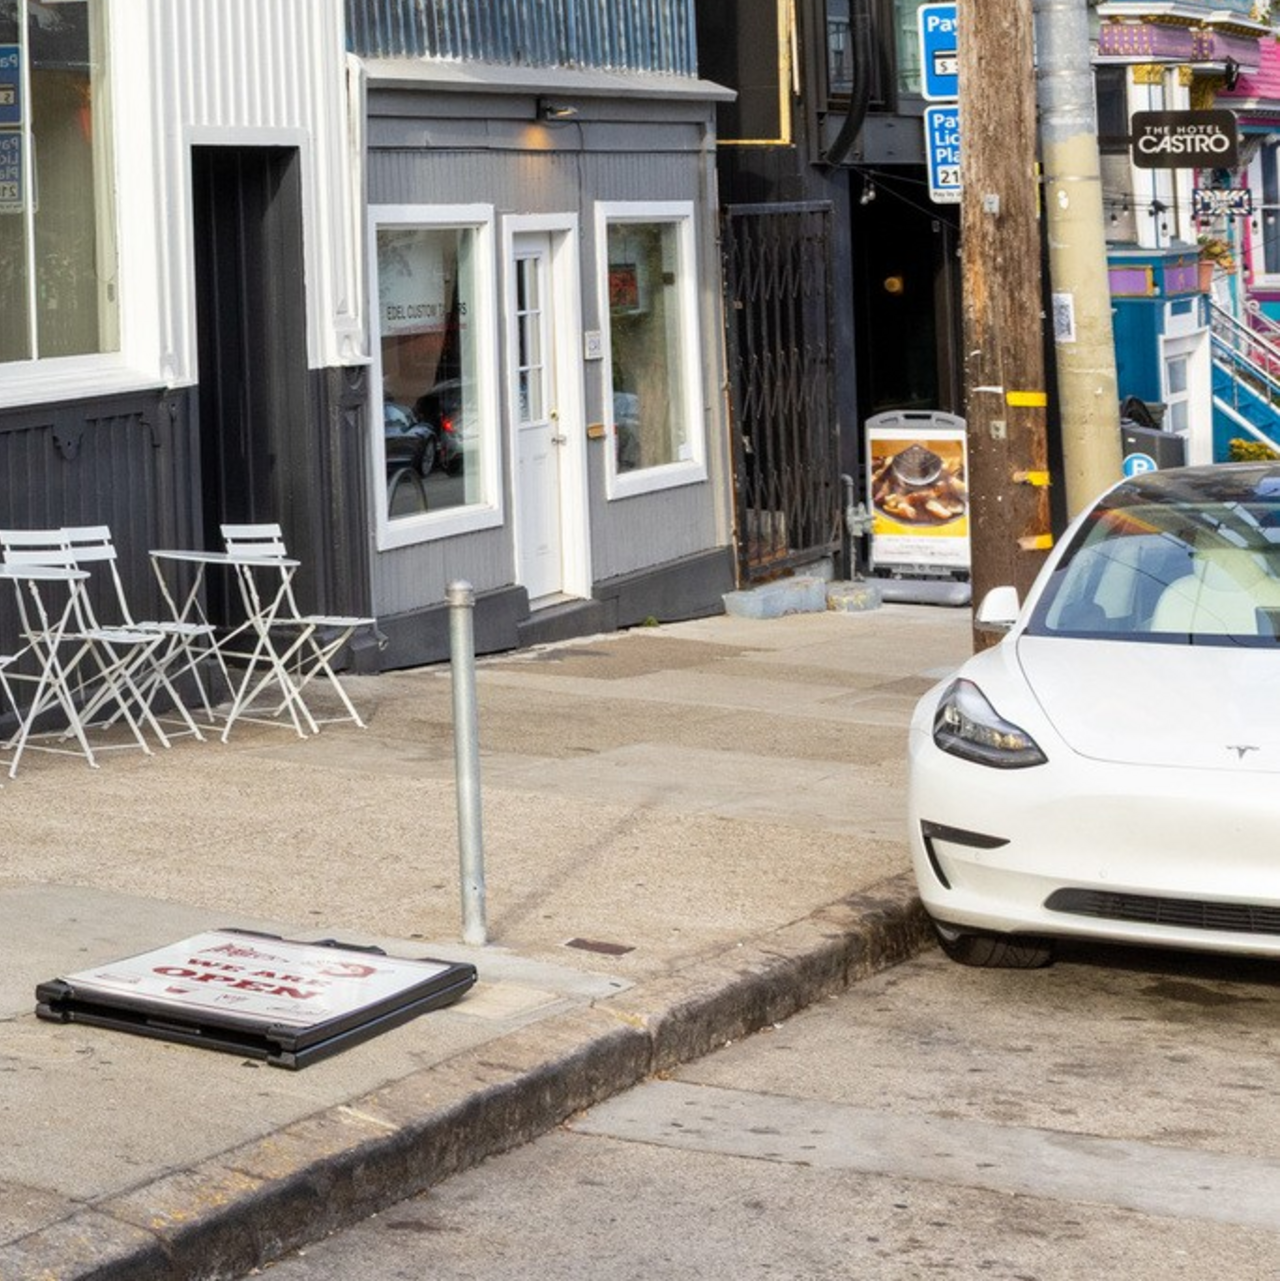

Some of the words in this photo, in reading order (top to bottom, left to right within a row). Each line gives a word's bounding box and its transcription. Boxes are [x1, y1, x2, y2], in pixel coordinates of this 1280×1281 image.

[1145, 126, 1170, 135] THE
[1177, 124, 1222, 134] HOTEL
[1138, 133, 1230, 154] CASTRO
[386, 306, 406, 320] EDEL
[187, 958, 245, 972] WE
[152, 966, 323, 1000] OPEN
